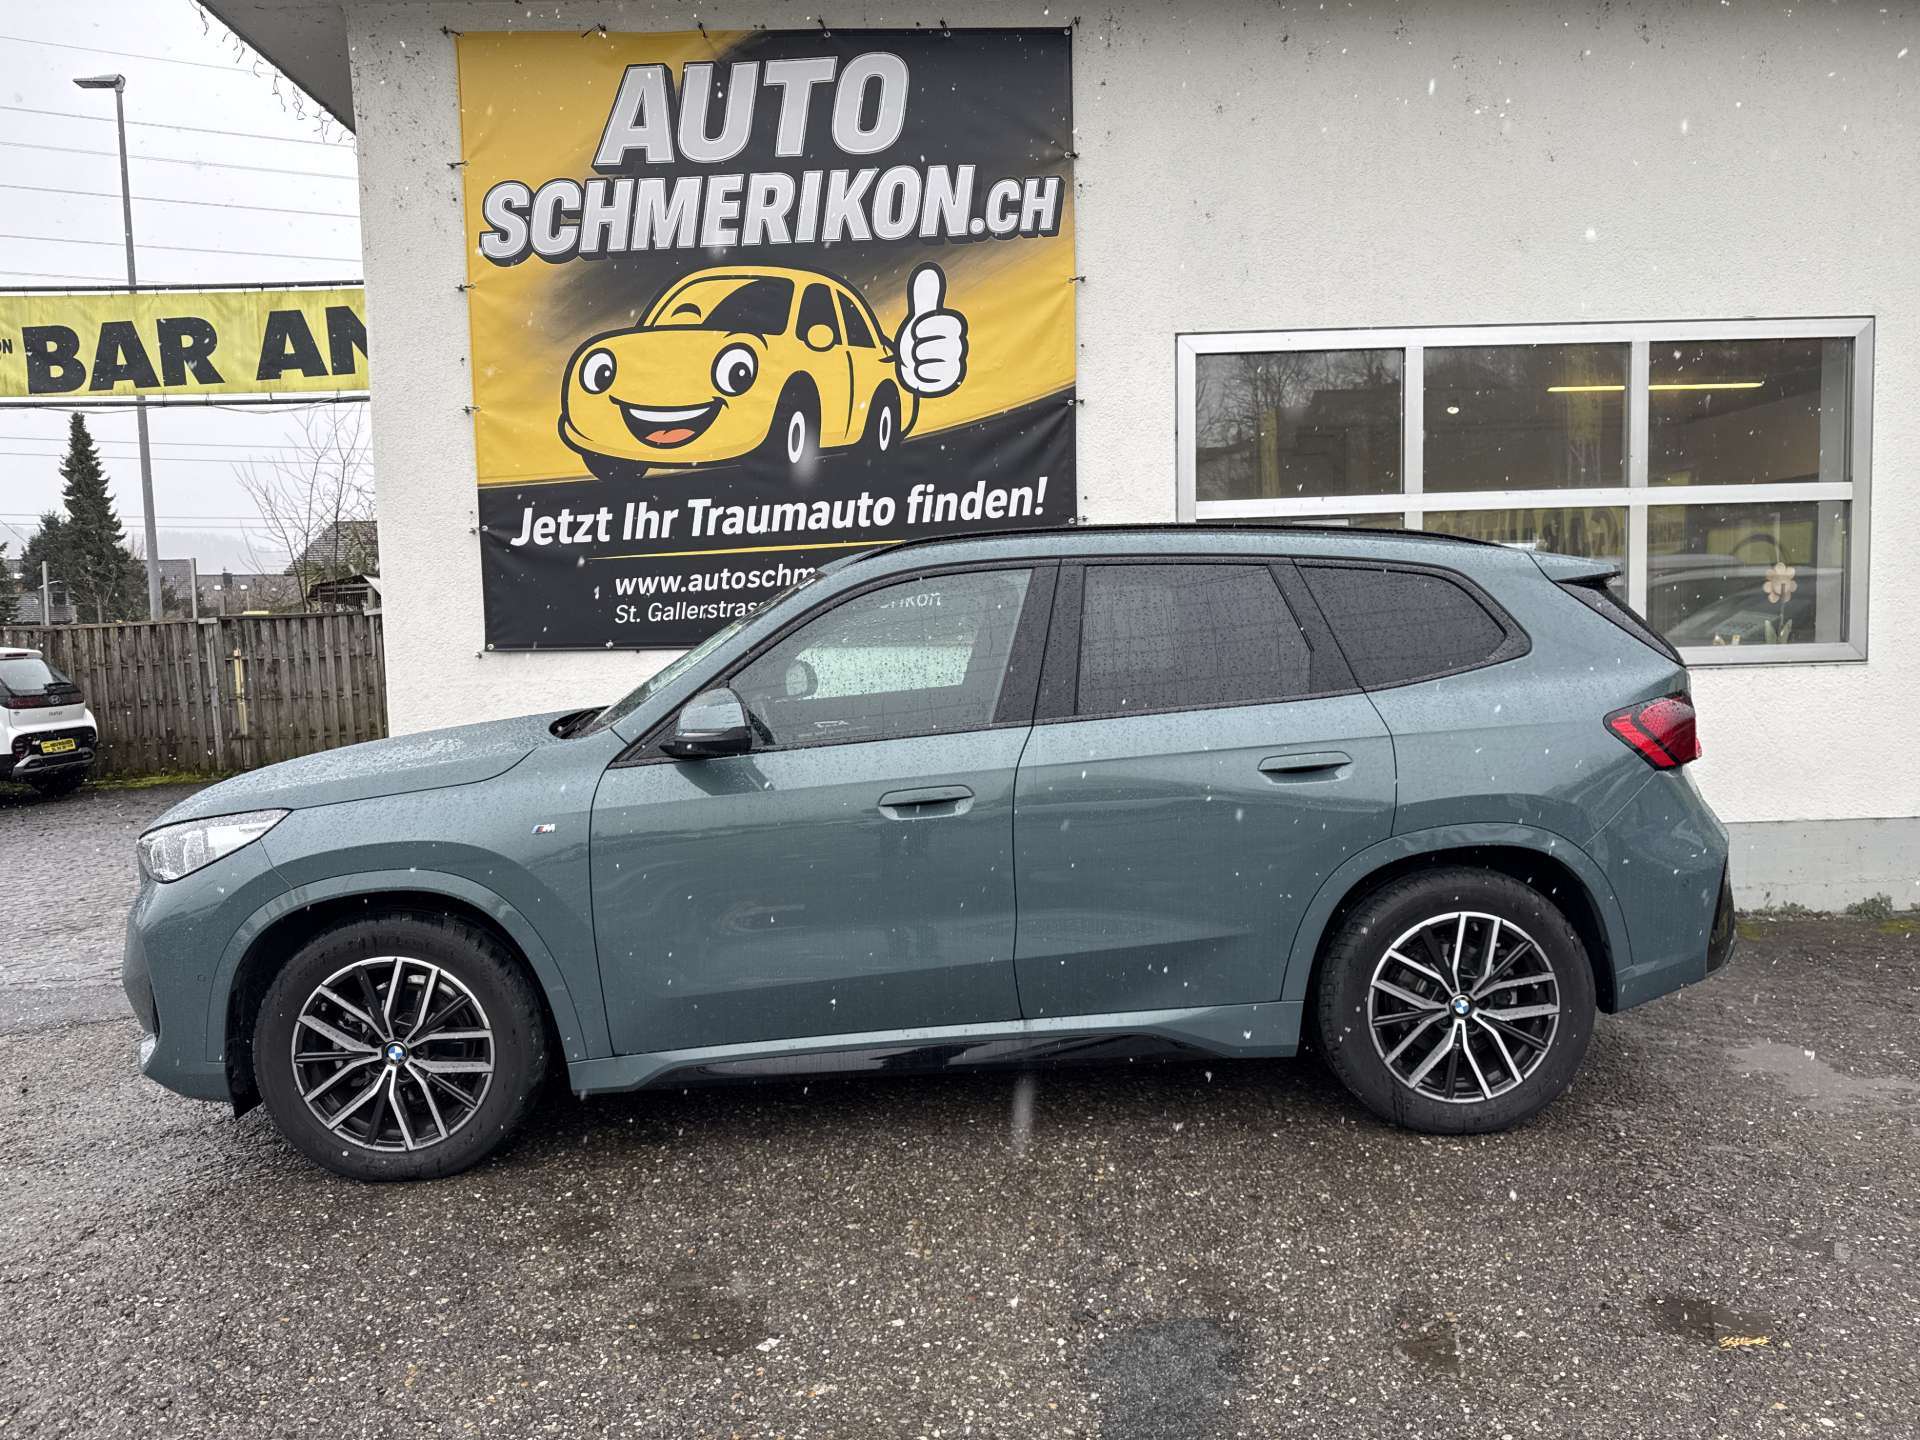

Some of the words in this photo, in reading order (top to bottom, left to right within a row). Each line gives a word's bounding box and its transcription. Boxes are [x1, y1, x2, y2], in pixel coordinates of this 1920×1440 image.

[594, 51, 909, 167] AUTO
[479, 164, 1061, 260] SCHMERIKON.CH
[22, 316, 226, 394] BAR
[511, 506, 612, 547] Jetzt
[622, 502, 678, 541] Ihr
[688, 491, 896, 537] Traumauto
[906, 476, 1048, 525] finden!
[614, 604, 641, 624] St.
[648, 601, 766, 622] Gallerstras
